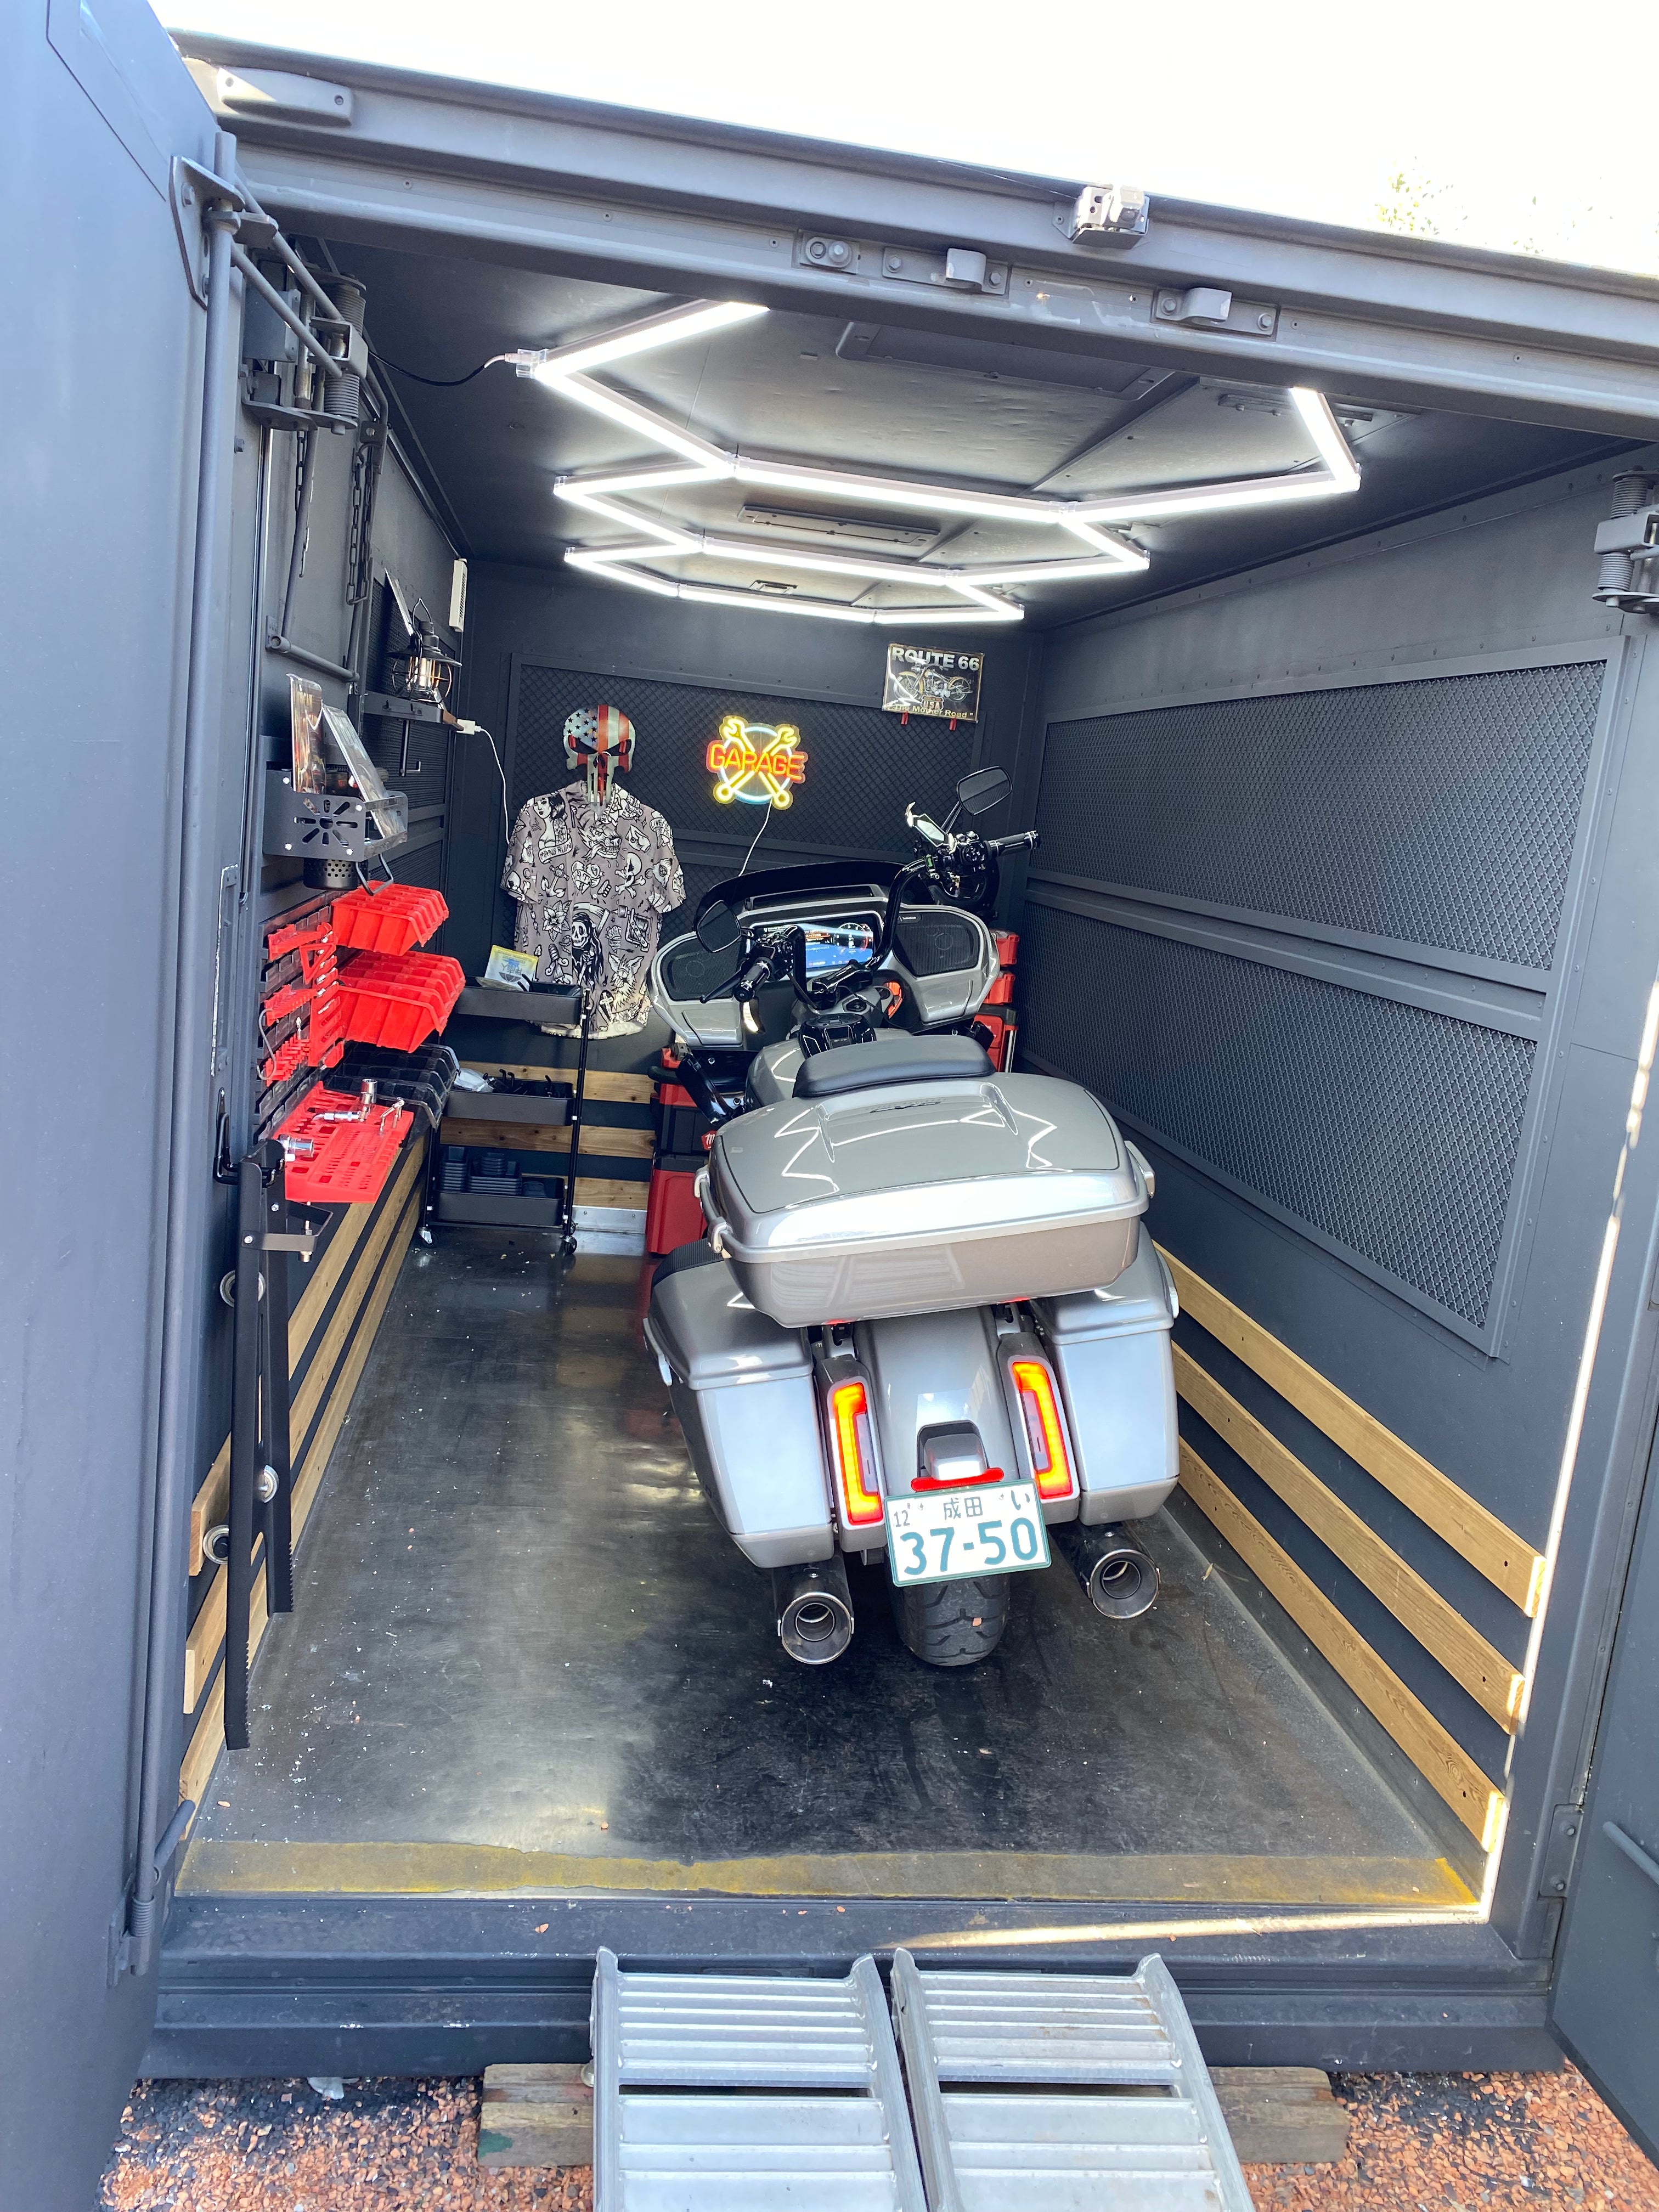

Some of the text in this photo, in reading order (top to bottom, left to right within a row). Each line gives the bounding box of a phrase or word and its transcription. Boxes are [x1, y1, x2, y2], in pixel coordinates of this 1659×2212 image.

[891, 647, 980, 671] ROUTE 66
[923, 700, 940, 710] USA
[944, 709, 967, 718] Road
[710, 743, 805, 780] GARAGE
[651, 820, 662, 828] LIVE
[557, 841, 572, 854] RUIN
[943, 1489, 1030, 1520] 成田 い
[894, 1510, 911, 1527] 12
[900, 1517, 1039, 1576] 37-50
